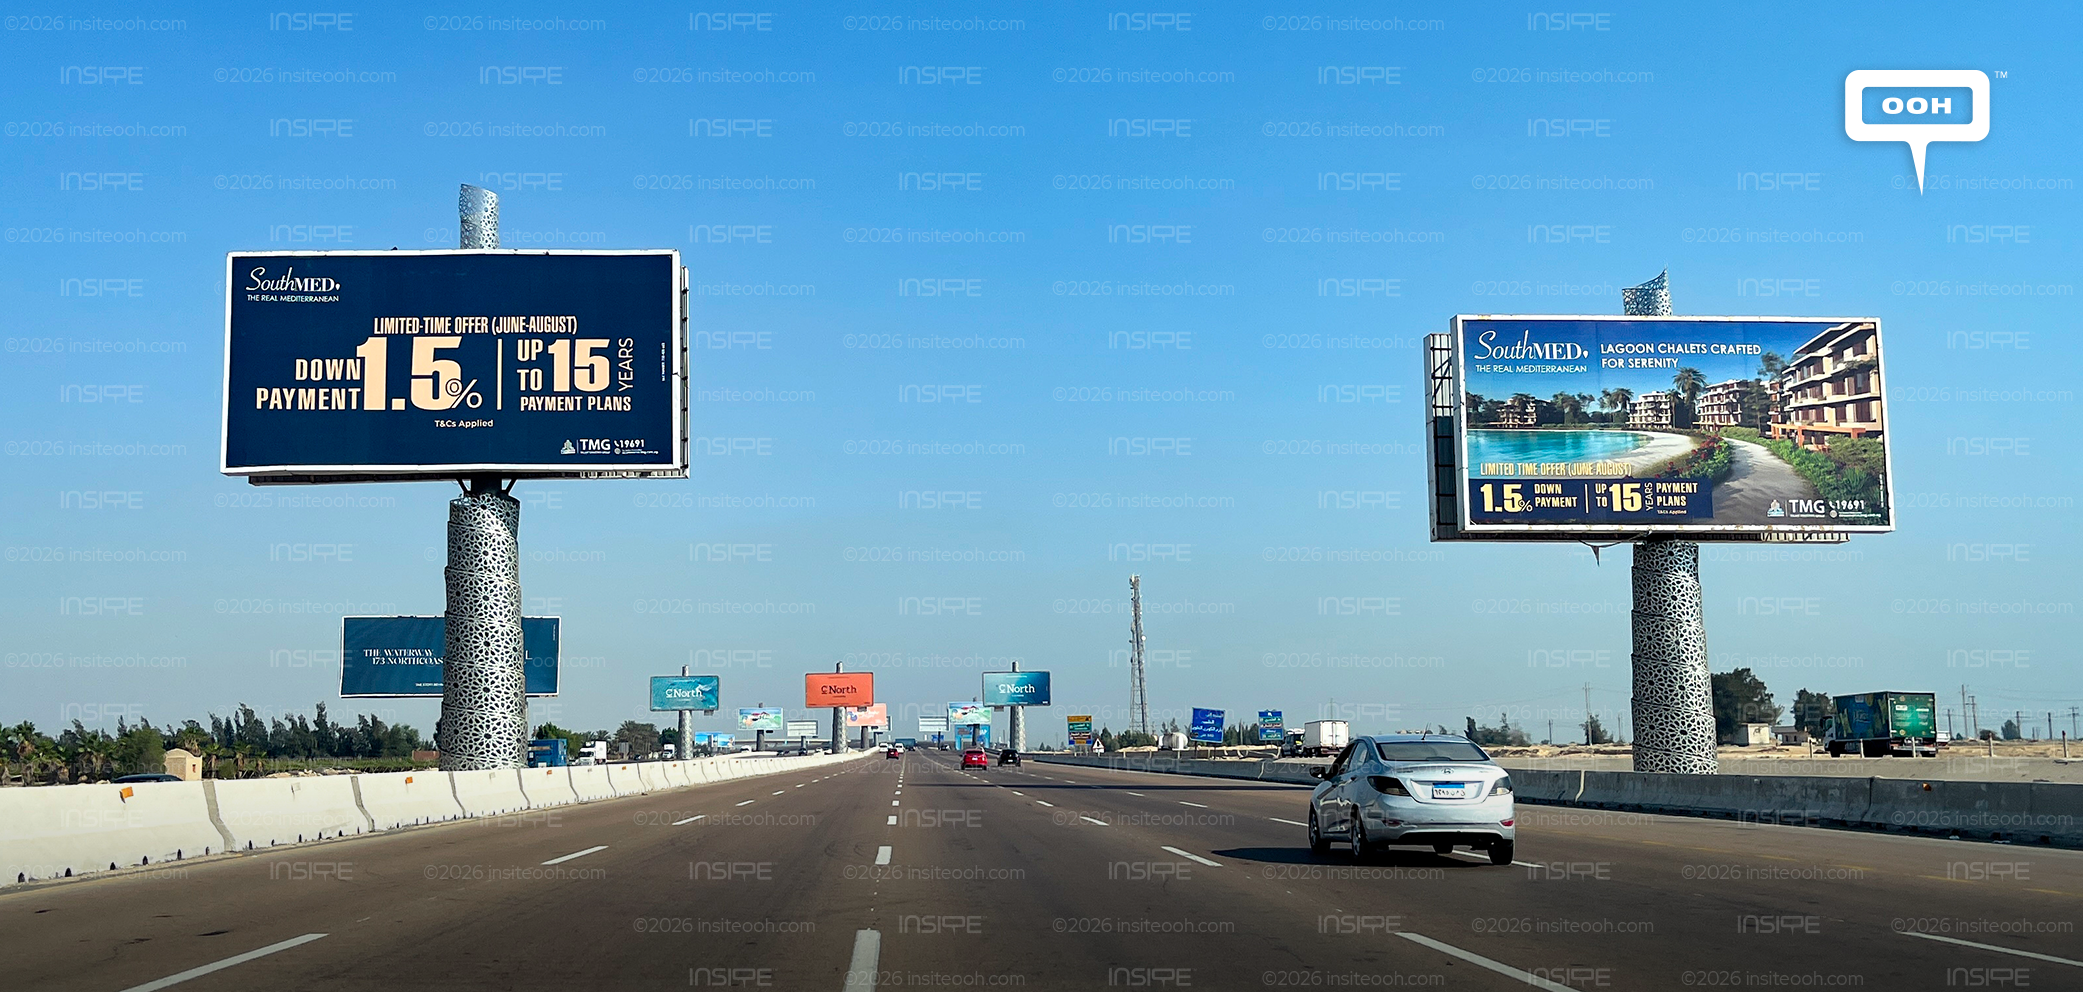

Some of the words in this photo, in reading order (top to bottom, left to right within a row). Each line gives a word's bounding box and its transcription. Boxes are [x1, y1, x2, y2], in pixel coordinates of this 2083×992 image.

[247, 294, 260, 302] THE
[280, 295, 340, 303] MEDITERRANEAN
[373, 317, 452, 334] LIMITED-TIME
[454, 316, 489, 334] OFFER
[491, 315, 578, 336] (JUNE-AUGUST)
[517, 339, 544, 362] UP
[1600, 343, 1655, 354] LAGOON
[1657, 343, 1708, 354] CHALETS
[1710, 344, 1762, 355] CRAFTED
[547, 338, 611, 393] 15
[617, 337, 634, 392] YEARS
[1475, 364, 1491, 373] THE
[1493, 364, 1513, 373] REAL
[1515, 364, 1588, 374] MEDITERRANEAN
[1601, 358, 1626, 369] FOR
[1628, 357, 1679, 369] SERENITY
[295, 358, 361, 381] DOWN
[516, 368, 543, 391] TO
[256, 387, 361, 410] PAYMENT
[520, 396, 584, 412] PAYMENT
[587, 396, 632, 411] PLANS
[434, 419, 457, 428] T&Cs
[458, 419, 494, 429] Applied
[579, 439, 611, 451] TMG
[619, 439, 645, 448] 19691
[1540, 462, 1567, 476] OFFER
[1534, 483, 1562, 494] DOWN
[1595, 483, 1607, 494] UP
[1656, 482, 1698, 493] PAYMENT
[1535, 496, 1578, 508] PAYMENT
[1595, 497, 1608, 508] TO
[1608, 483, 1642, 512] 15
[1644, 482, 1654, 511] YEARS
[1656, 495, 1687, 506] PLANS
[1788, 499, 1826, 513] TMG
[1835, 500, 1865, 510] 19691
[363, 649, 382, 657] THE
[383, 649, 434, 657] WATERWAY
[372, 657, 386, 665] 173
